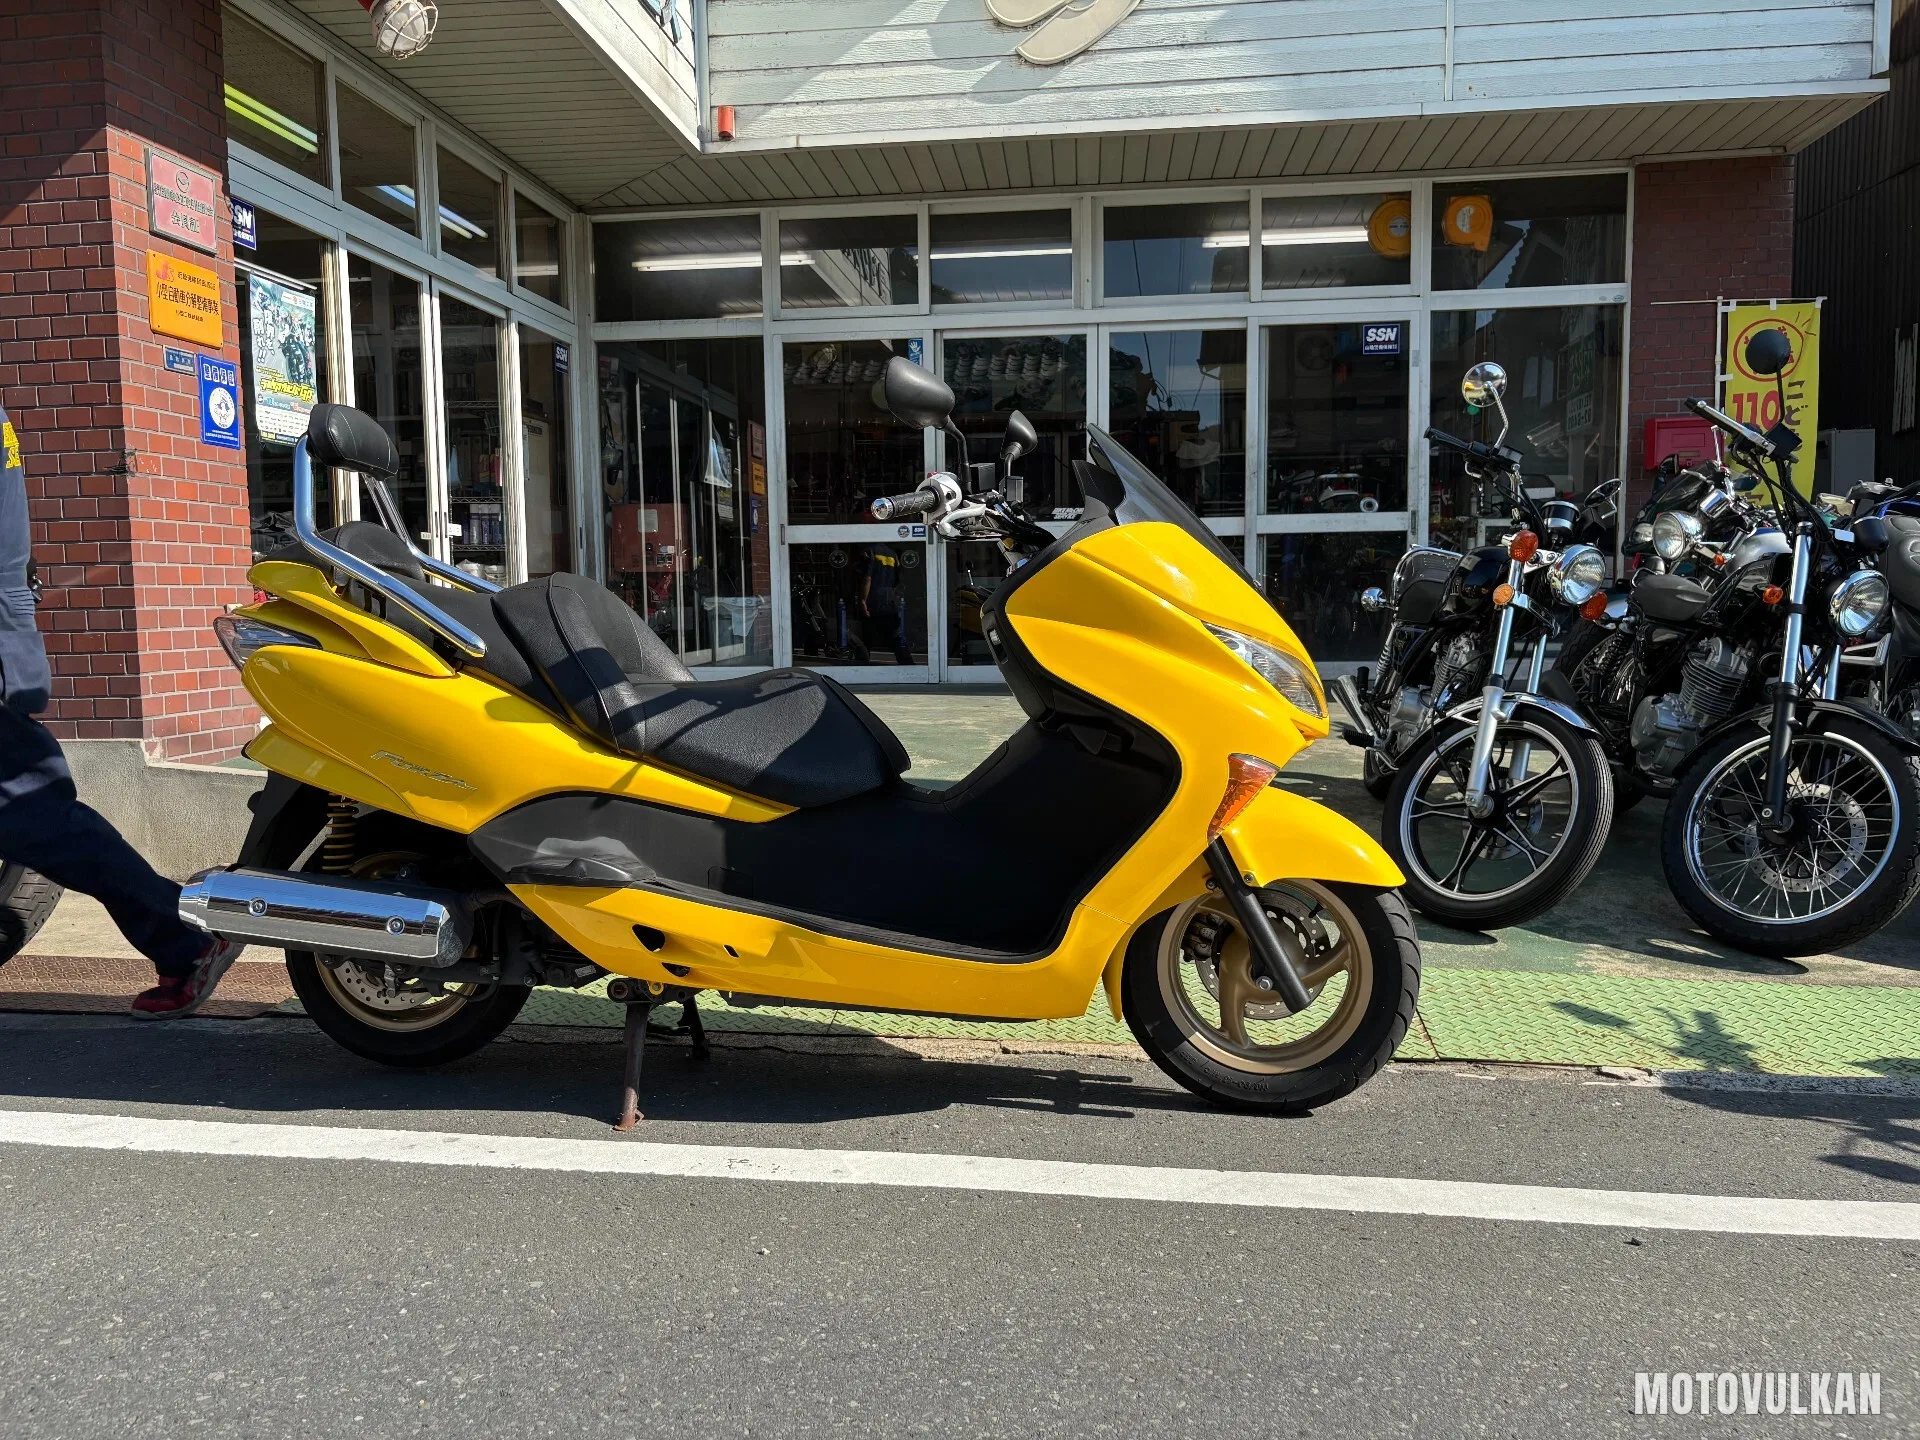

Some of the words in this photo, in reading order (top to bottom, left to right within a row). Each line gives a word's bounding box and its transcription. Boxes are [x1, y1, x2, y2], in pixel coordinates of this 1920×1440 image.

[1365, 327, 1398, 342] SSN
[555, 346, 568, 362] SSN
[1732, 389, 1783, 431] 110
